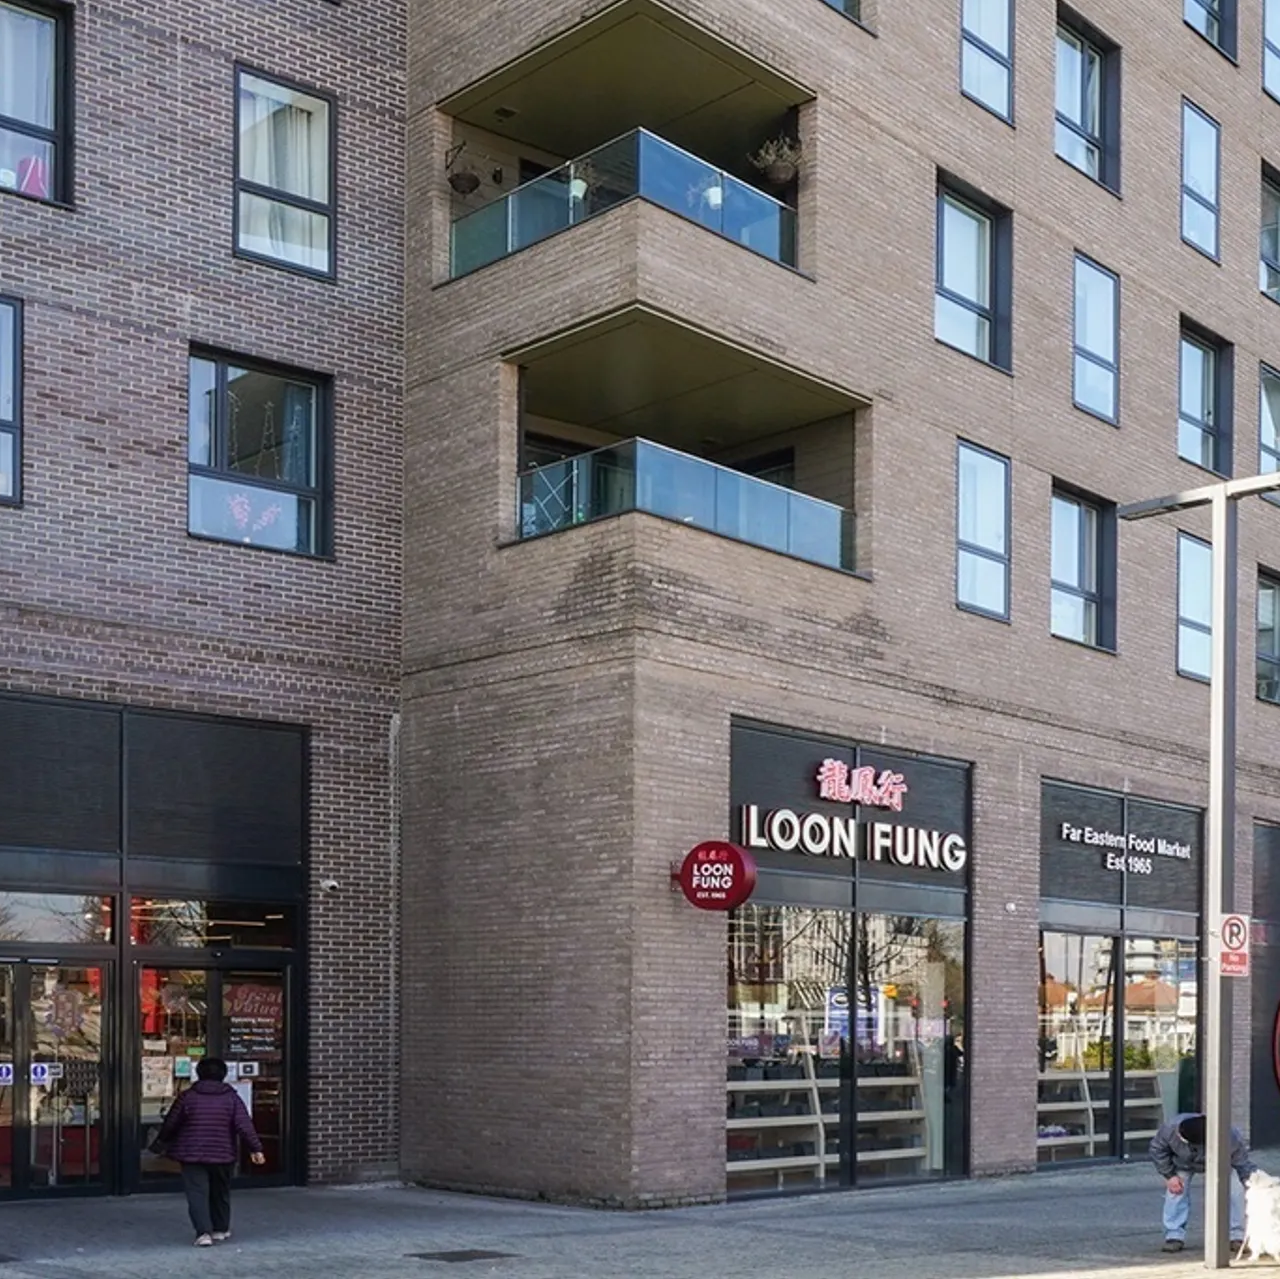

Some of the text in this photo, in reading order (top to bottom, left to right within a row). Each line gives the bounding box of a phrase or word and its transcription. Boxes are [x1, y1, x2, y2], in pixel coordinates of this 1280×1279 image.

[742, 804, 967, 871] LOON FUNG
[1062, 822, 1191, 859] Far Eastern Food Market
[693, 863, 734, 876] LOON
[1127, 856, 1152, 874] 1965
[692, 876, 733, 889] FUNG
